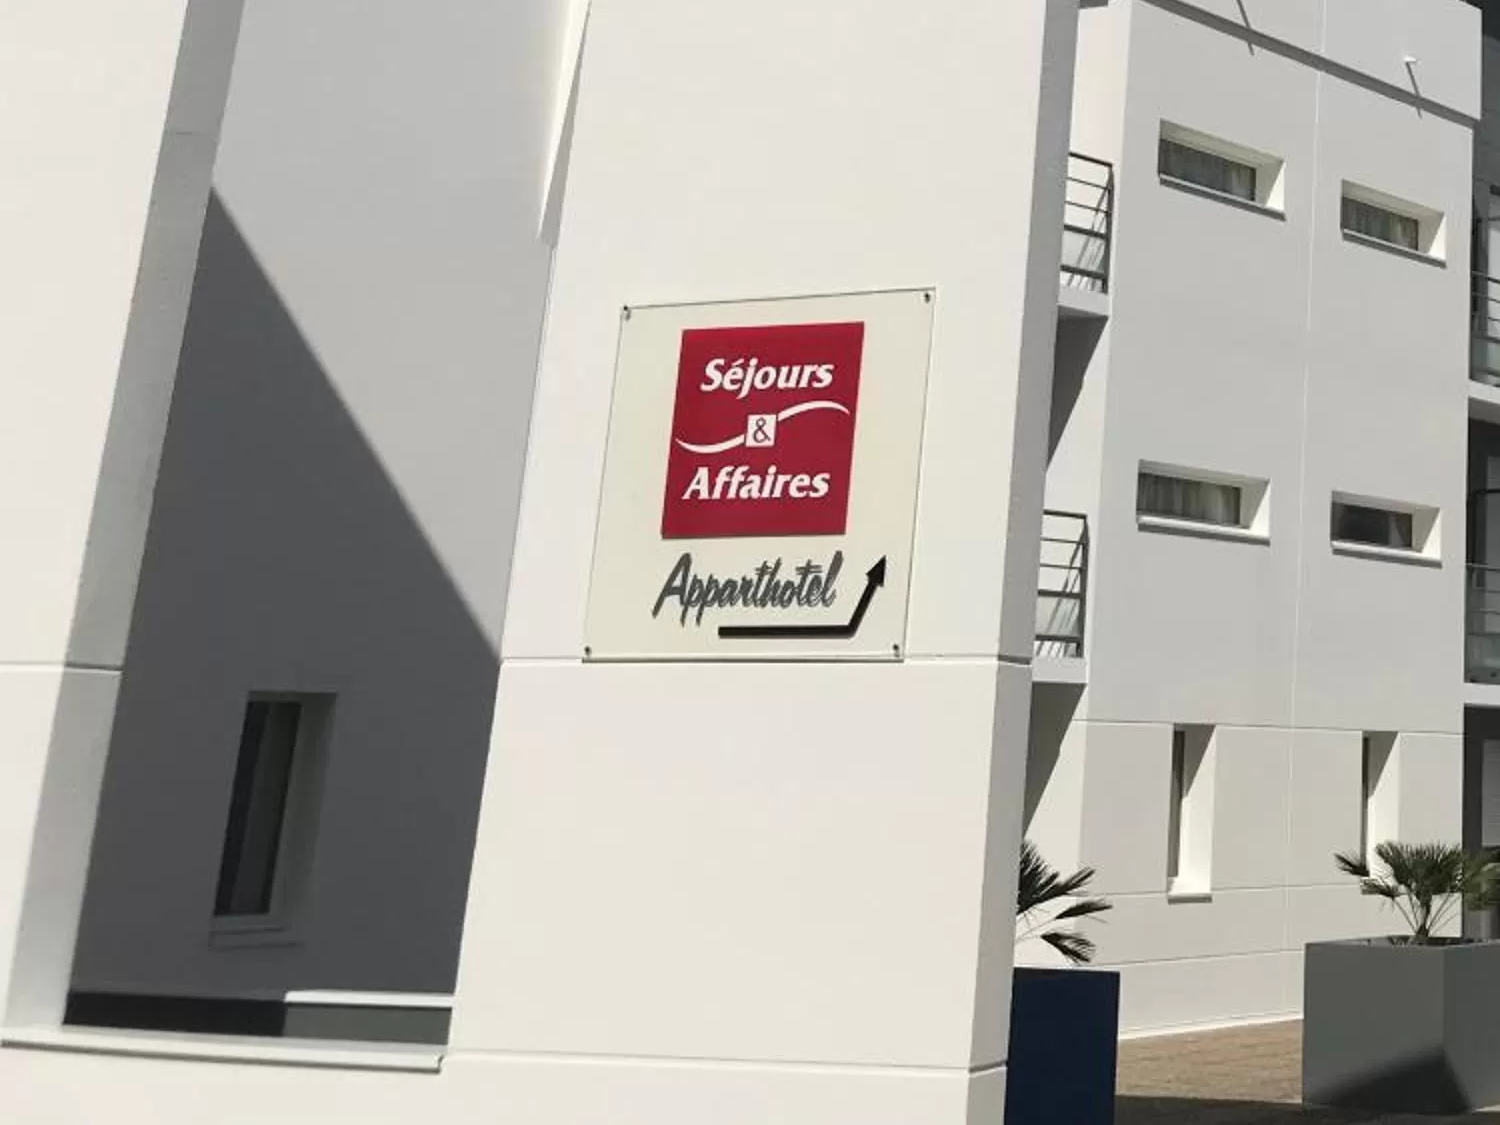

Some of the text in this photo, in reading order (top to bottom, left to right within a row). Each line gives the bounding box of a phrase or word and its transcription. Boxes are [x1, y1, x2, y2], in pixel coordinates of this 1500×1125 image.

[701, 358, 834, 399] Séjours
[752, 417, 771, 444] &
[682, 465, 830, 500] Affaires
[652, 550, 844, 627] Apparthotel
